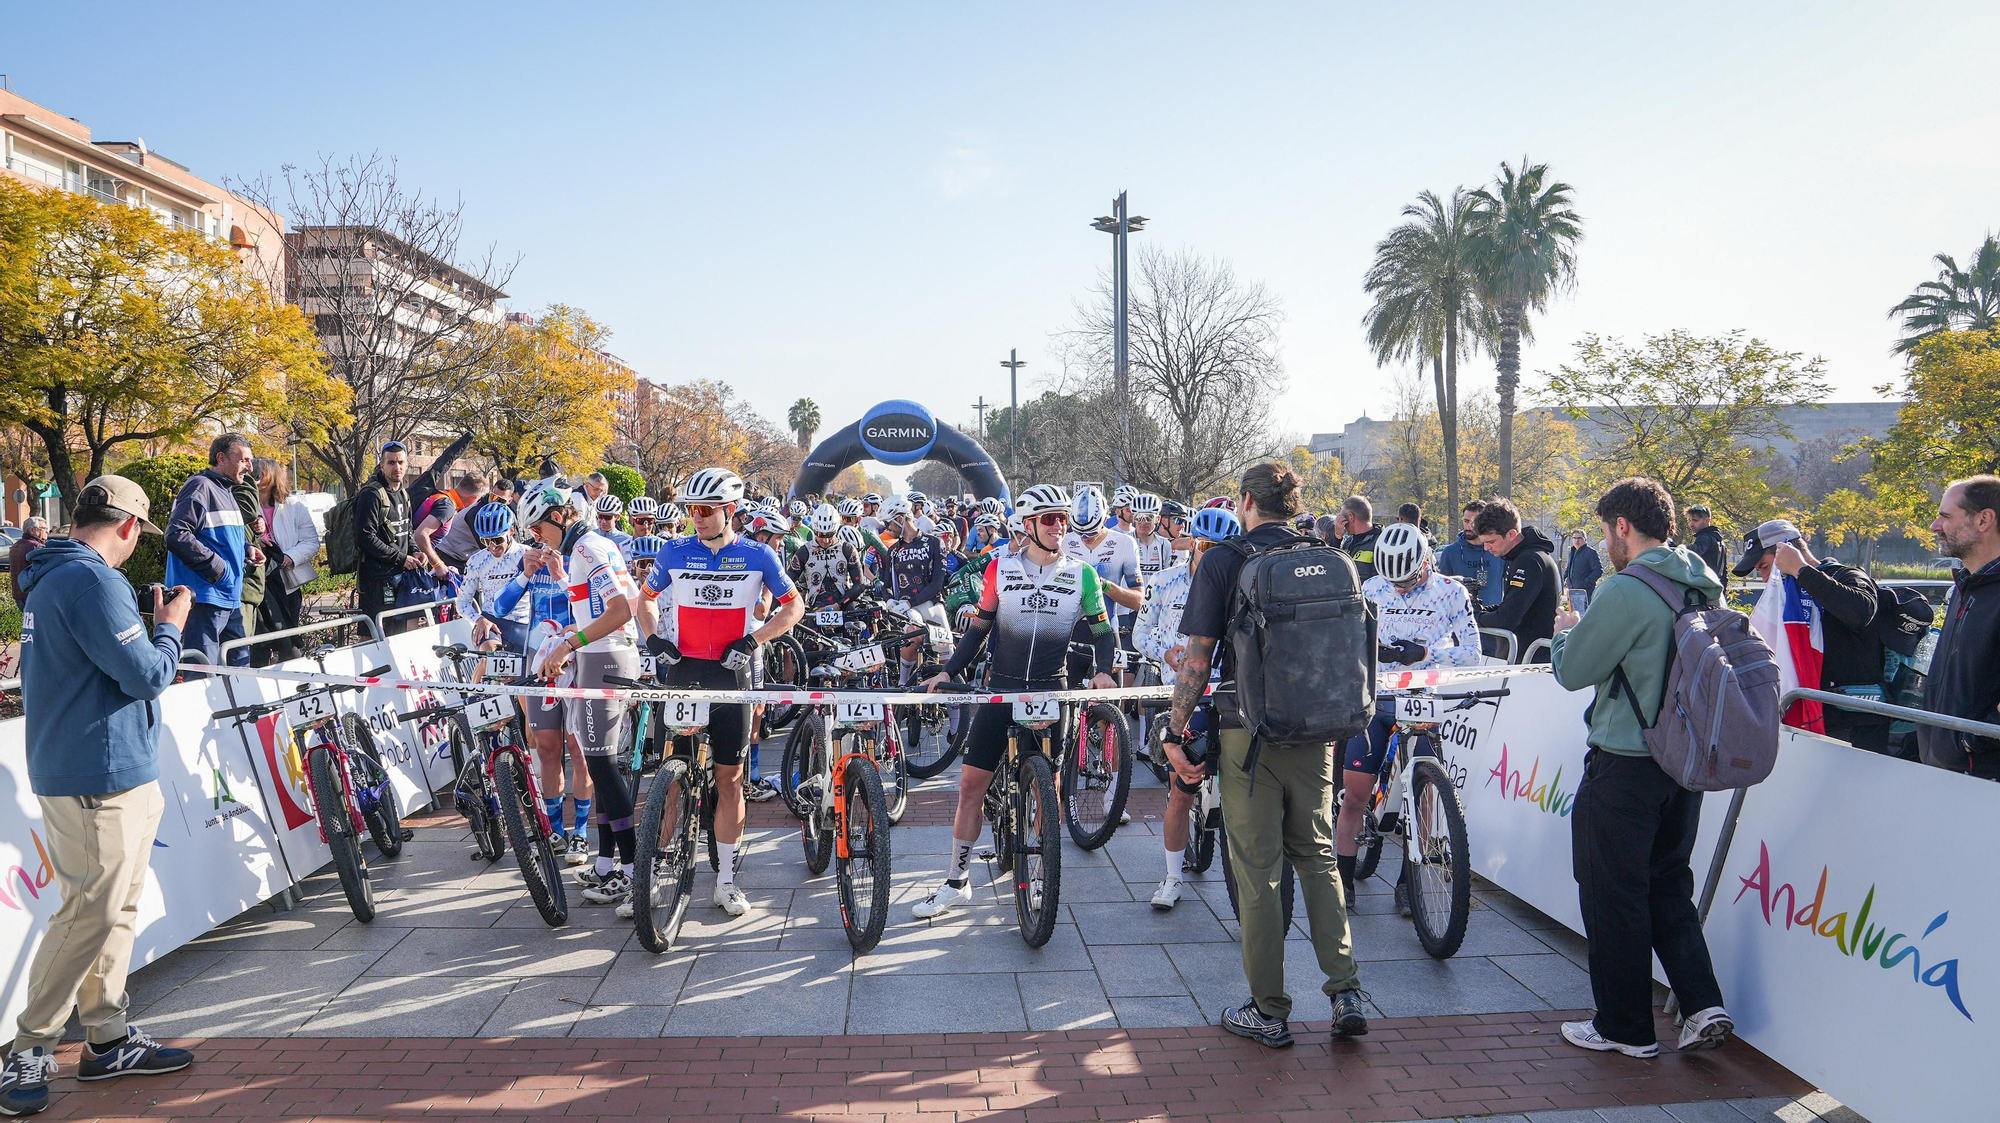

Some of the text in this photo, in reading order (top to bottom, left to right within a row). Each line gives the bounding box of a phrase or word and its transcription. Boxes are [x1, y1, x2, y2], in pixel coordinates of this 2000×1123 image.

[961, 461, 989, 469] garmin.com
[1294, 565, 1325, 577] evoc
[820, 612, 839, 624] 52-2
[1385, 608, 1436, 616] SCOTT
[1403, 616, 1436, 626] BANDIDA
[933, 627, 949, 640] 16-2
[859, 648, 876, 664] 1-1
[493, 658, 516, 673] 19-1
[299, 697, 324, 719] 4-2
[480, 699, 501, 720] 4-1
[676, 702, 697, 721] 8-1
[848, 703, 875, 716] 12-1
[1025, 702, 1048, 716] 8-2
[1405, 699, 1435, 718] 49-1
[1441, 714, 1478, 750] ción
[379, 740, 412, 770] doba
[1484, 742, 1575, 817] Andaluc
[1733, 839, 1974, 1023] Andalucía
